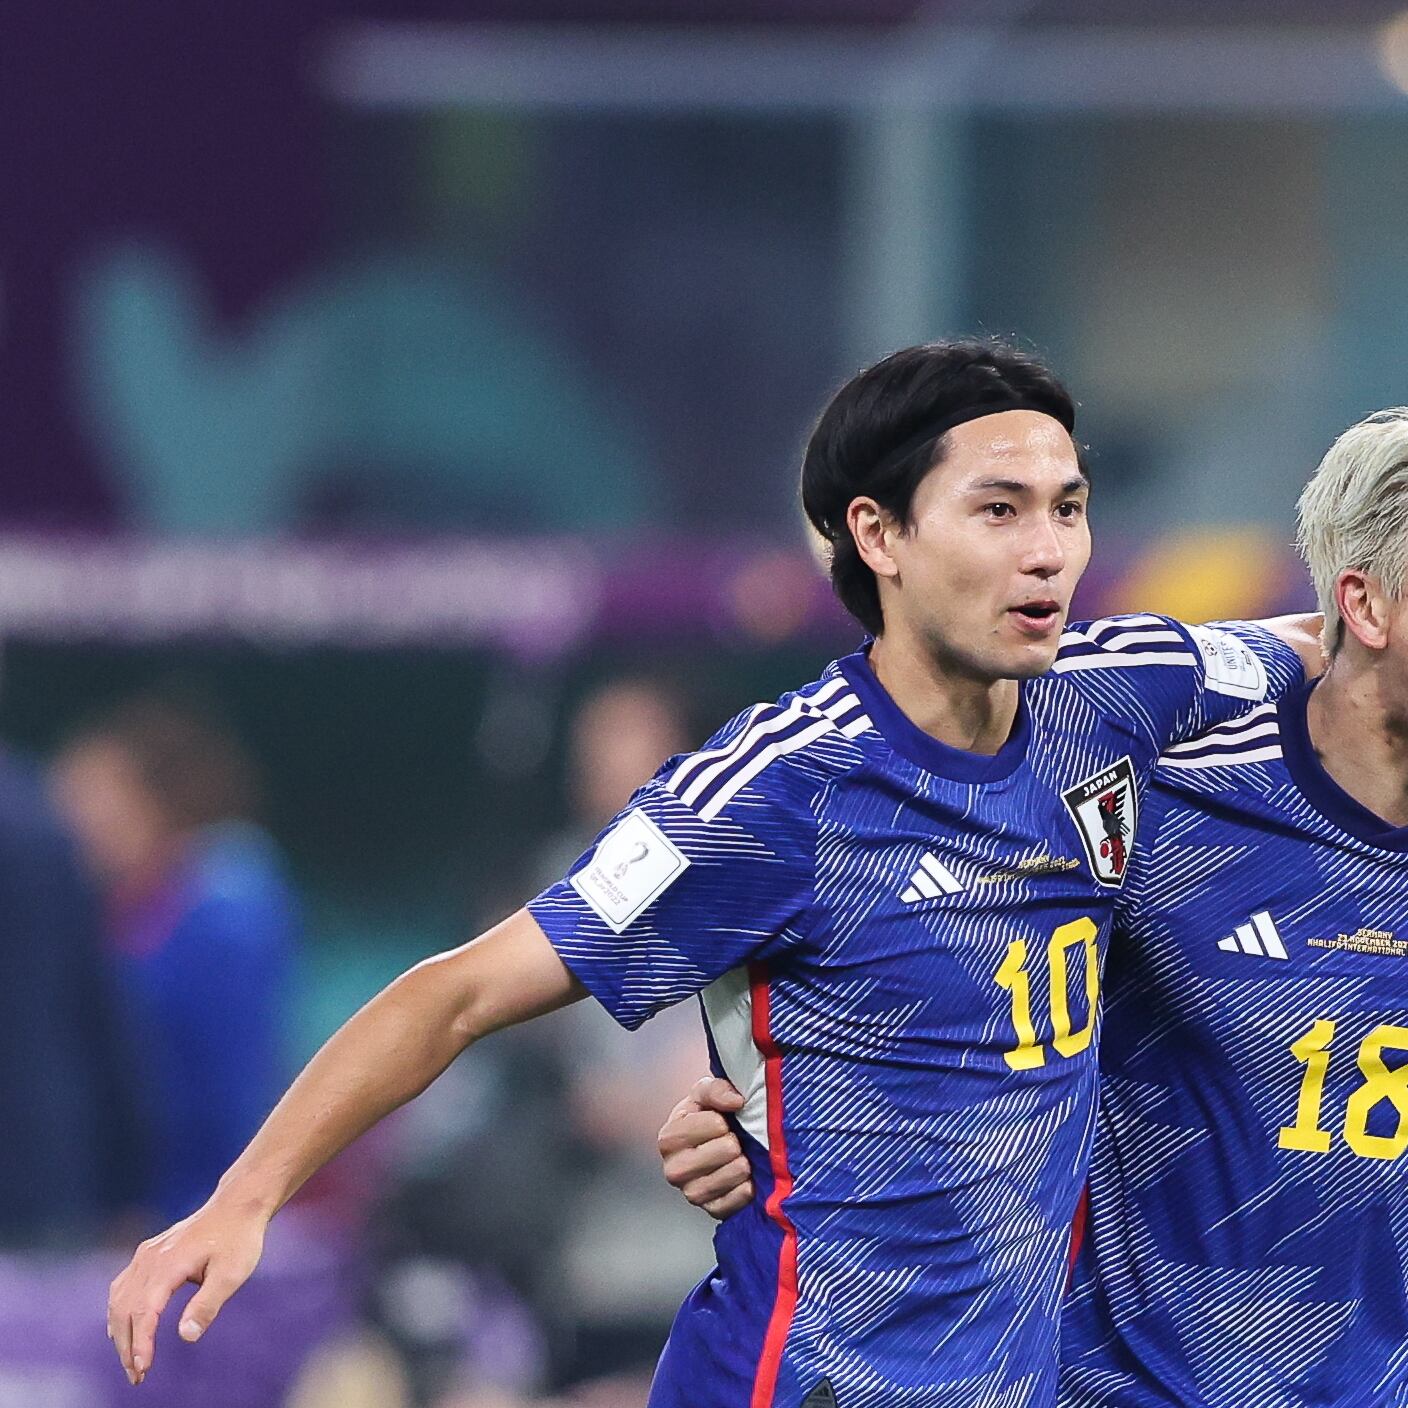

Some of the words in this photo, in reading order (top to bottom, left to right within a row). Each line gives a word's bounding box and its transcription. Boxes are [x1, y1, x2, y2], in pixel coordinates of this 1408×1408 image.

[1083, 770, 1118, 798] JAPAN
[1358, 928, 1393, 940] GERMANY
[1344, 943, 1406, 957] INTERNATIONAL
[994, 916, 1099, 1071] 10
